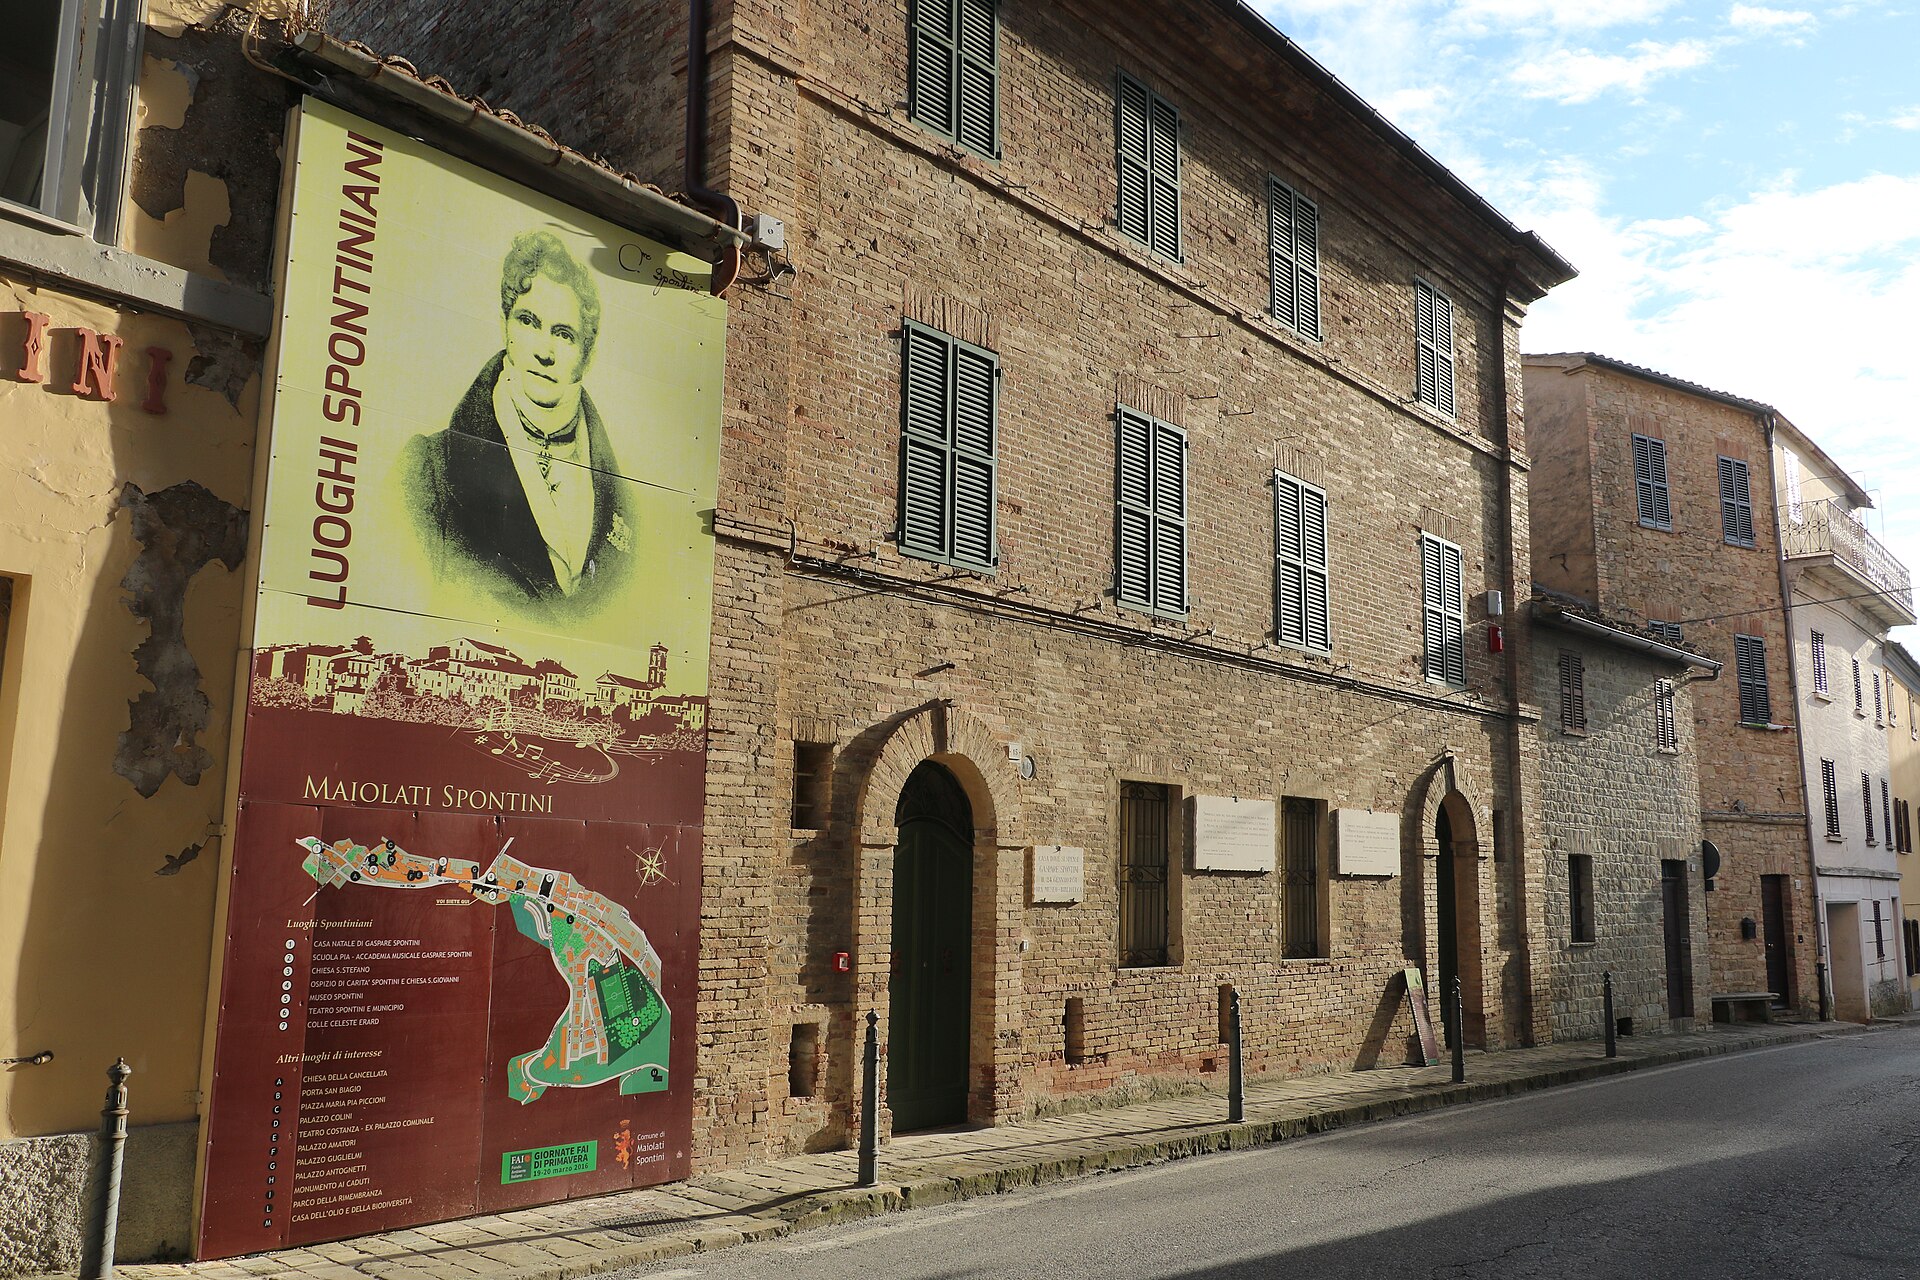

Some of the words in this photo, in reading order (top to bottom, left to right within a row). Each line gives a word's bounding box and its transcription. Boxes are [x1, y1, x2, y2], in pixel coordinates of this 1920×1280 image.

[326, 130, 384, 426] SPONTINIANI
[306, 435, 359, 610] LUOGHI
[443, 785, 553, 813] SPONTINI
[287, 919, 318, 930] Luoghi
[320, 919, 373, 930] Spontiniani
[356, 952, 391, 960] ACCADEMIA
[311, 980, 336, 988] OSPIZIO
[372, 978, 399, 986] SPONTINI
[309, 1007, 334, 1015] TEATRO
[372, 1004, 404, 1012] MUNICIPIO
[307, 1020, 328, 1028] COLLE
[359, 1018, 379, 1026] ERARD
[276, 1053, 299, 1064] Altri
[301, 1052, 330, 1064] luoghi
[333, 1051, 342, 1061] di
[344, 1049, 382, 1059] interesse
[303, 1075, 326, 1083] CHIESA
[328, 1073, 348, 1081] DELLA
[350, 1070, 387, 1079] CANCELLATA
[325, 1087, 338, 1095] SAN
[339, 1085, 361, 1093] BIAGIO
[301, 1102, 324, 1110] PIAZZA
[326, 1100, 346, 1108] MARIA
[347, 1099, 357, 1107] PIA
[359, 1097, 385, 1105] PICCIONI
[300, 1115, 329, 1124] PALAZZO
[331, 1113, 352, 1121] COLINI
[299, 1129, 325, 1138] TEATRO
[326, 1126, 359, 1136] COSTANZA
[375, 1121, 401, 1130] PALAZZO
[402, 1117, 434, 1127] COMUNALE
[637, 1132, 658, 1140] Comune
[298, 1143, 327, 1151] PALAZZO
[328, 1140, 356, 1149] AMATORI
[637, 1141, 664, 1152] Maiolati
[297, 1156, 326, 1165] PALAZZO
[328, 1152, 362, 1162] GUGLIELMI
[535, 1147, 574, 1160] GIORNATE
[577, 1145, 588, 1153] FAI
[637, 1152, 664, 1165] Spontini
[511, 1155, 524, 1164] FAI
[534, 1161, 542, 1169] DI
[544, 1154, 588, 1167] PRIMAVERA
[296, 1170, 324, 1179] PALAZZO
[326, 1165, 366, 1176] ANTOGNETTI
[553, 1166, 572, 1174] marzo
[294, 1183, 336, 1194] MONUMENTO
[346, 1178, 369, 1187] CADUTI
[293, 1198, 315, 1208] PARCO
[316, 1195, 337, 1205] DELLA
[338, 1190, 382, 1202] RIMEMBRANZA
[292, 1213, 309, 1222] CASA
[311, 1209, 344, 1220] DELL'OLIO
[351, 1205, 370, 1213] DELLA
